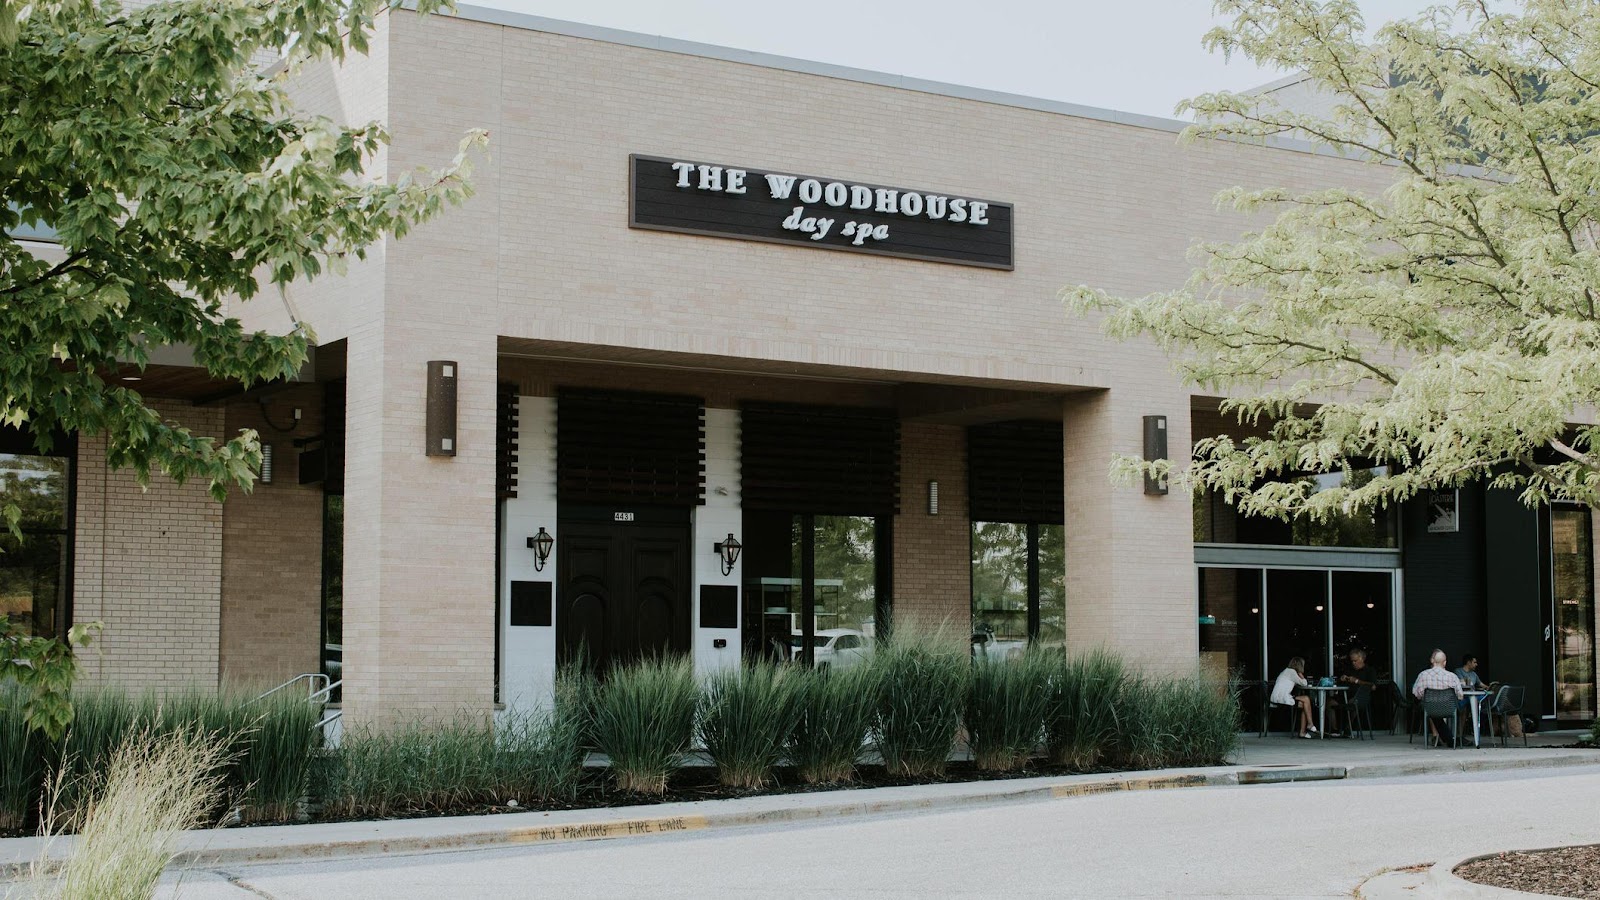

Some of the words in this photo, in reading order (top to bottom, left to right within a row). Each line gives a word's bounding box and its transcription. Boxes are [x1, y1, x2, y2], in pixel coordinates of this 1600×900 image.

[672, 162, 747, 194] THE
[764, 174, 989, 226] WOODHOUSE
[782, 206, 834, 241] day
[840, 220, 889, 246] spa
[541, 828, 555, 840] NO
[562, 824, 607, 839] PARKING
[628, 821, 652, 834] FIRE
[659, 818, 686, 831] LANE
